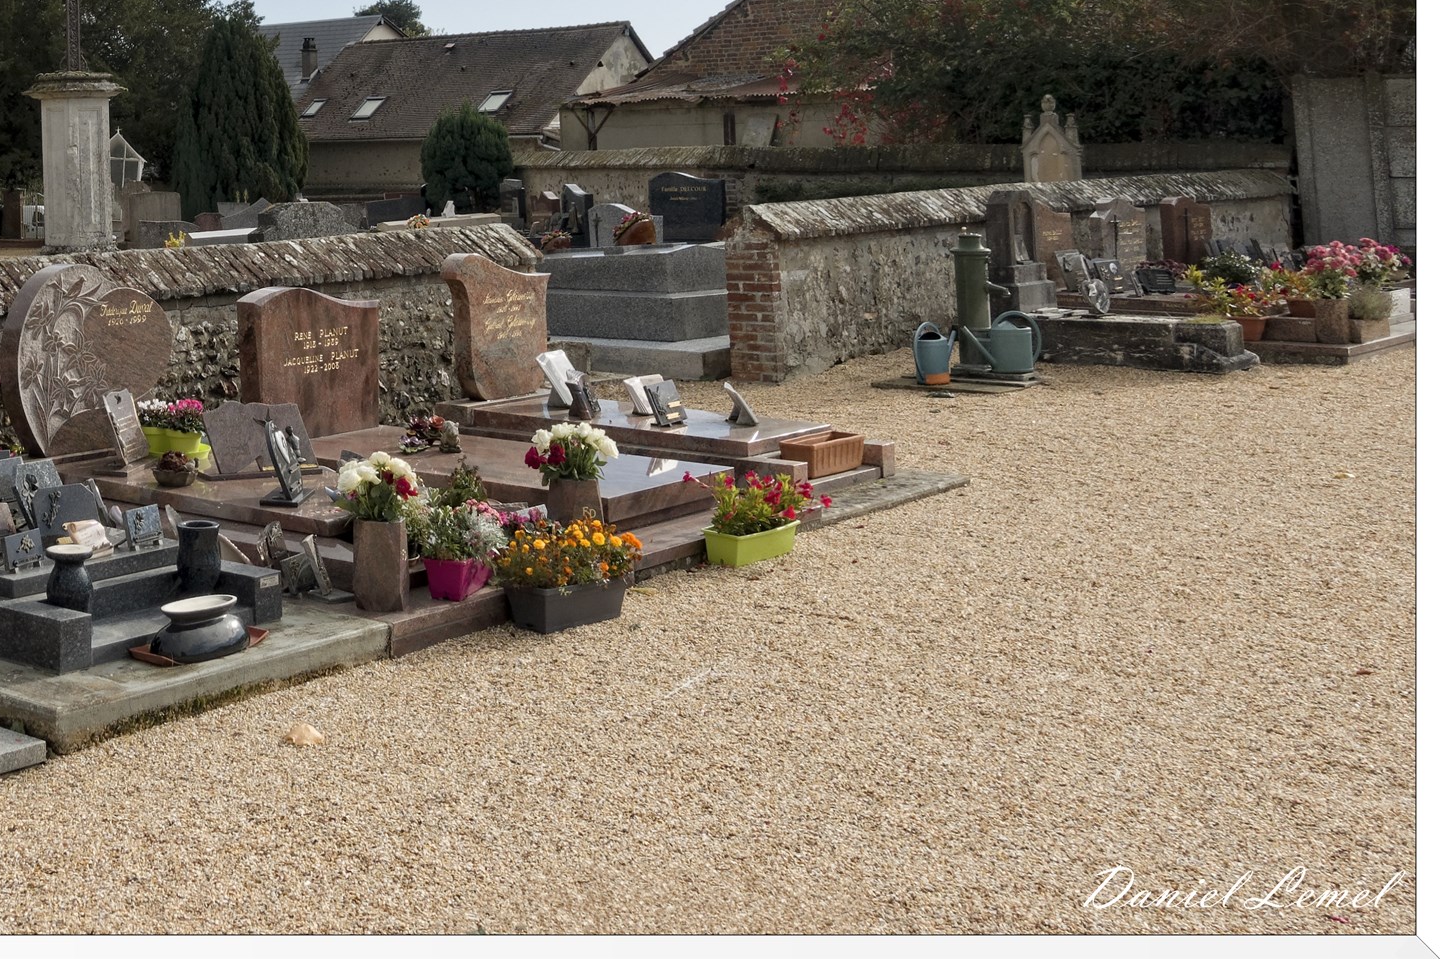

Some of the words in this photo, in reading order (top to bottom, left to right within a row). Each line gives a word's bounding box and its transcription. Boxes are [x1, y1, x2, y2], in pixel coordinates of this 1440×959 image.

[129, 314, 147, 325] 1999
[319, 326, 348, 338] PLANUT
[283, 354, 323, 367] JACQUELINE
[331, 348, 359, 361] PLANUT
